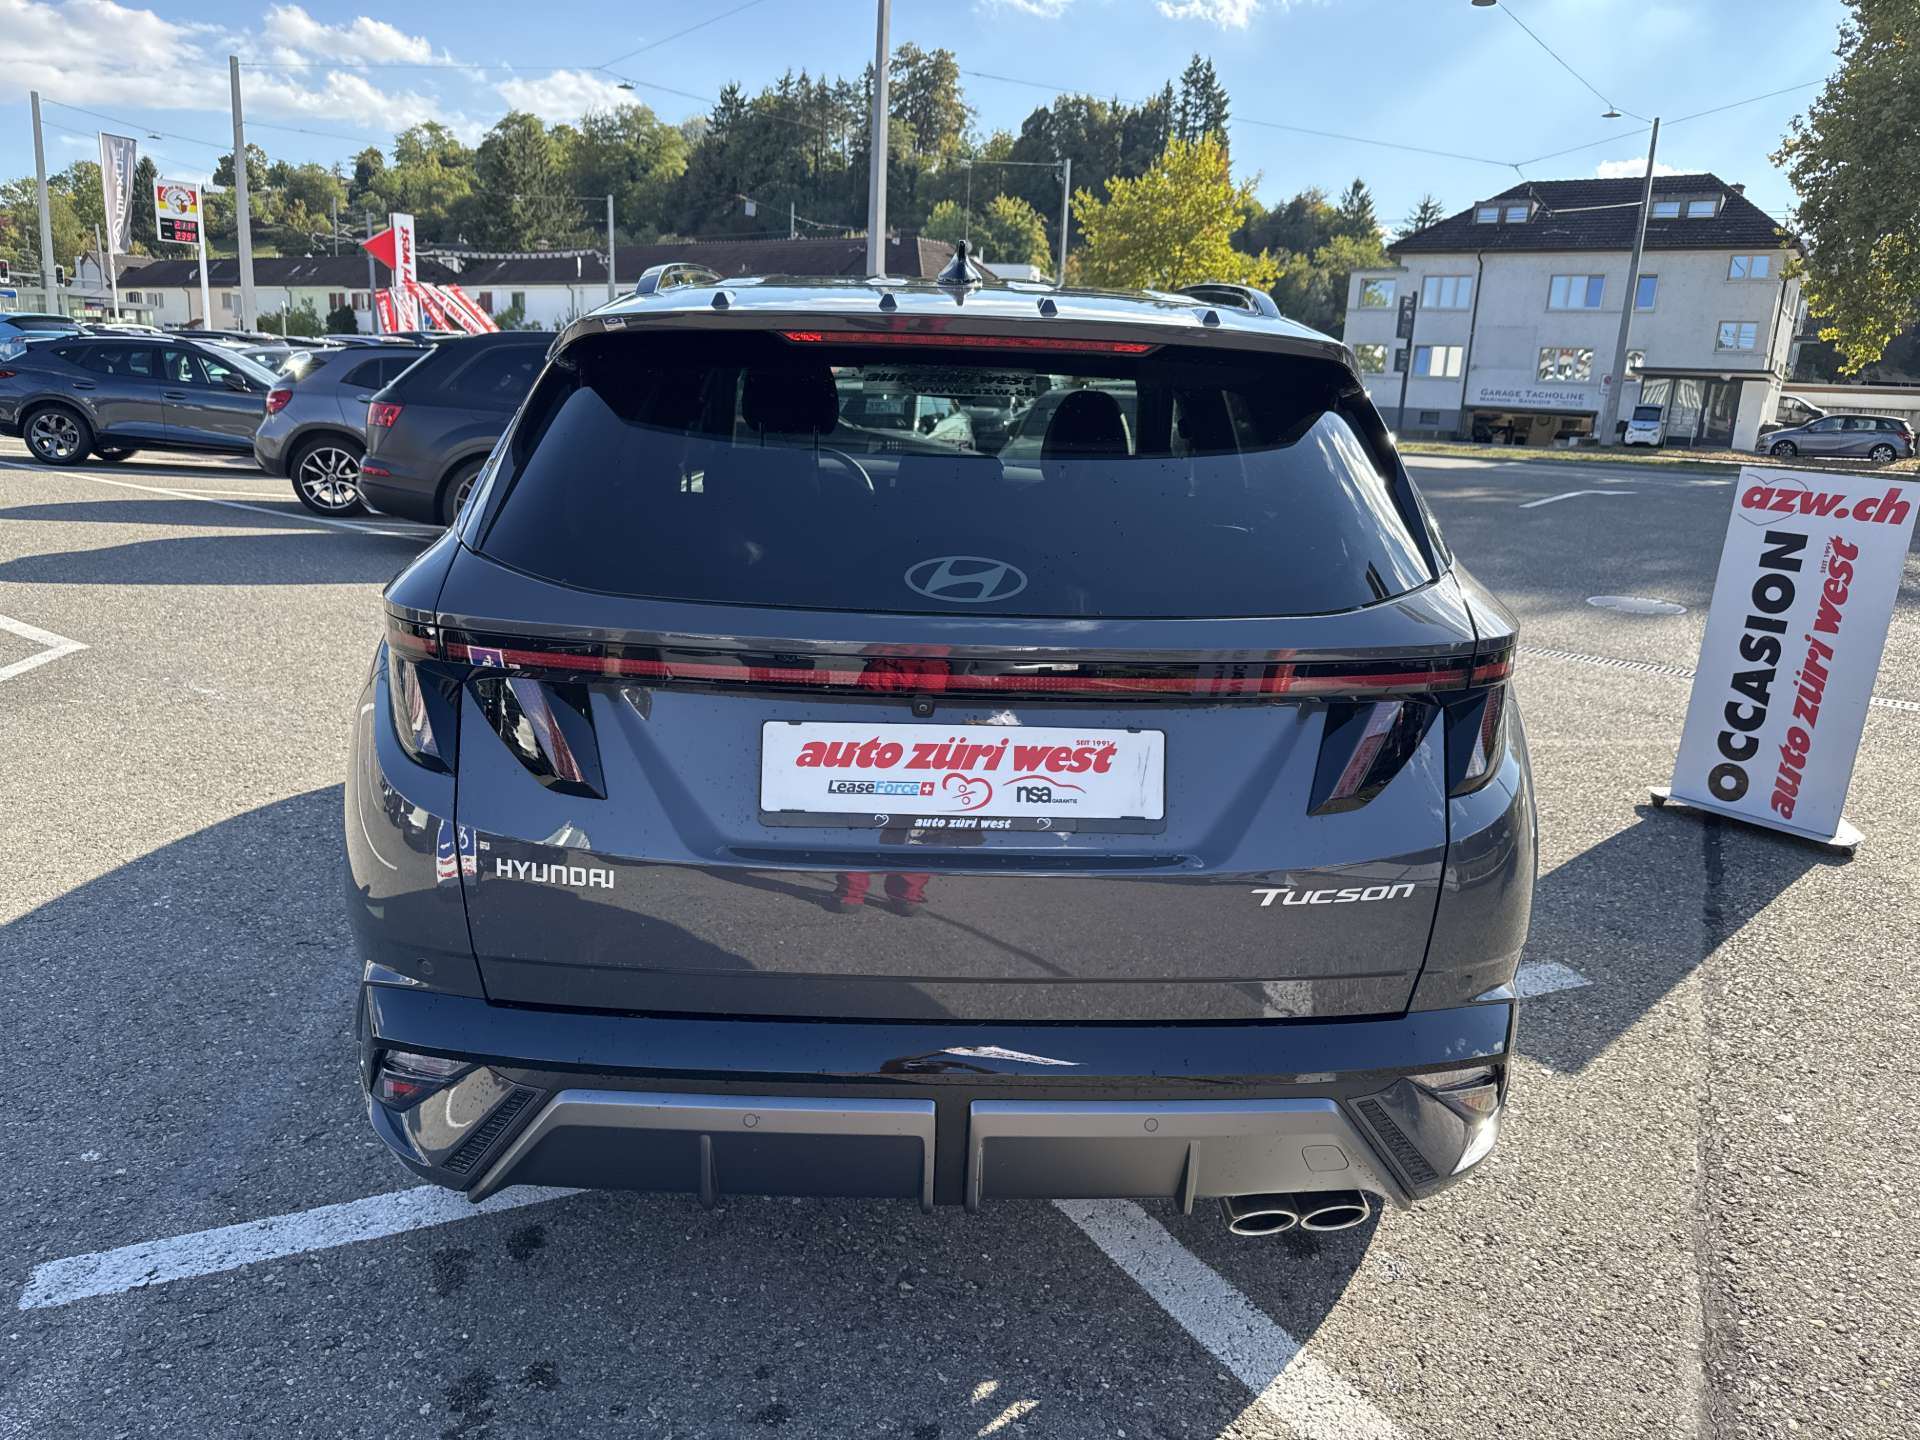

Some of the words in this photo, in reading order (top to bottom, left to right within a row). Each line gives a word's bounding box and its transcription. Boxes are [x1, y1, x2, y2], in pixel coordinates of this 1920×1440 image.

[1480, 388, 1521, 398] GARAGE
[1526, 390, 1585, 400] TACHOLINE
[1741, 486, 1911, 526] azw.ch
[1820, 557, 1830, 574] SEIT
[1813, 535, 1859, 635] west
[1708, 530, 1809, 802] OCCASION
[1792, 633, 1835, 730] züri
[795, 736, 904, 769] auto
[904, 737, 1009, 771] züri
[1013, 742, 1118, 774] west
[827, 779, 920, 795] LeaseForce
[1770, 725, 1811, 821] auto
[1016, 786, 1052, 804] nsa
[914, 817, 946, 828] auto
[949, 817, 977, 828] züri
[980, 819, 1012, 829] west
[496, 857, 615, 889] HYUNDAI
